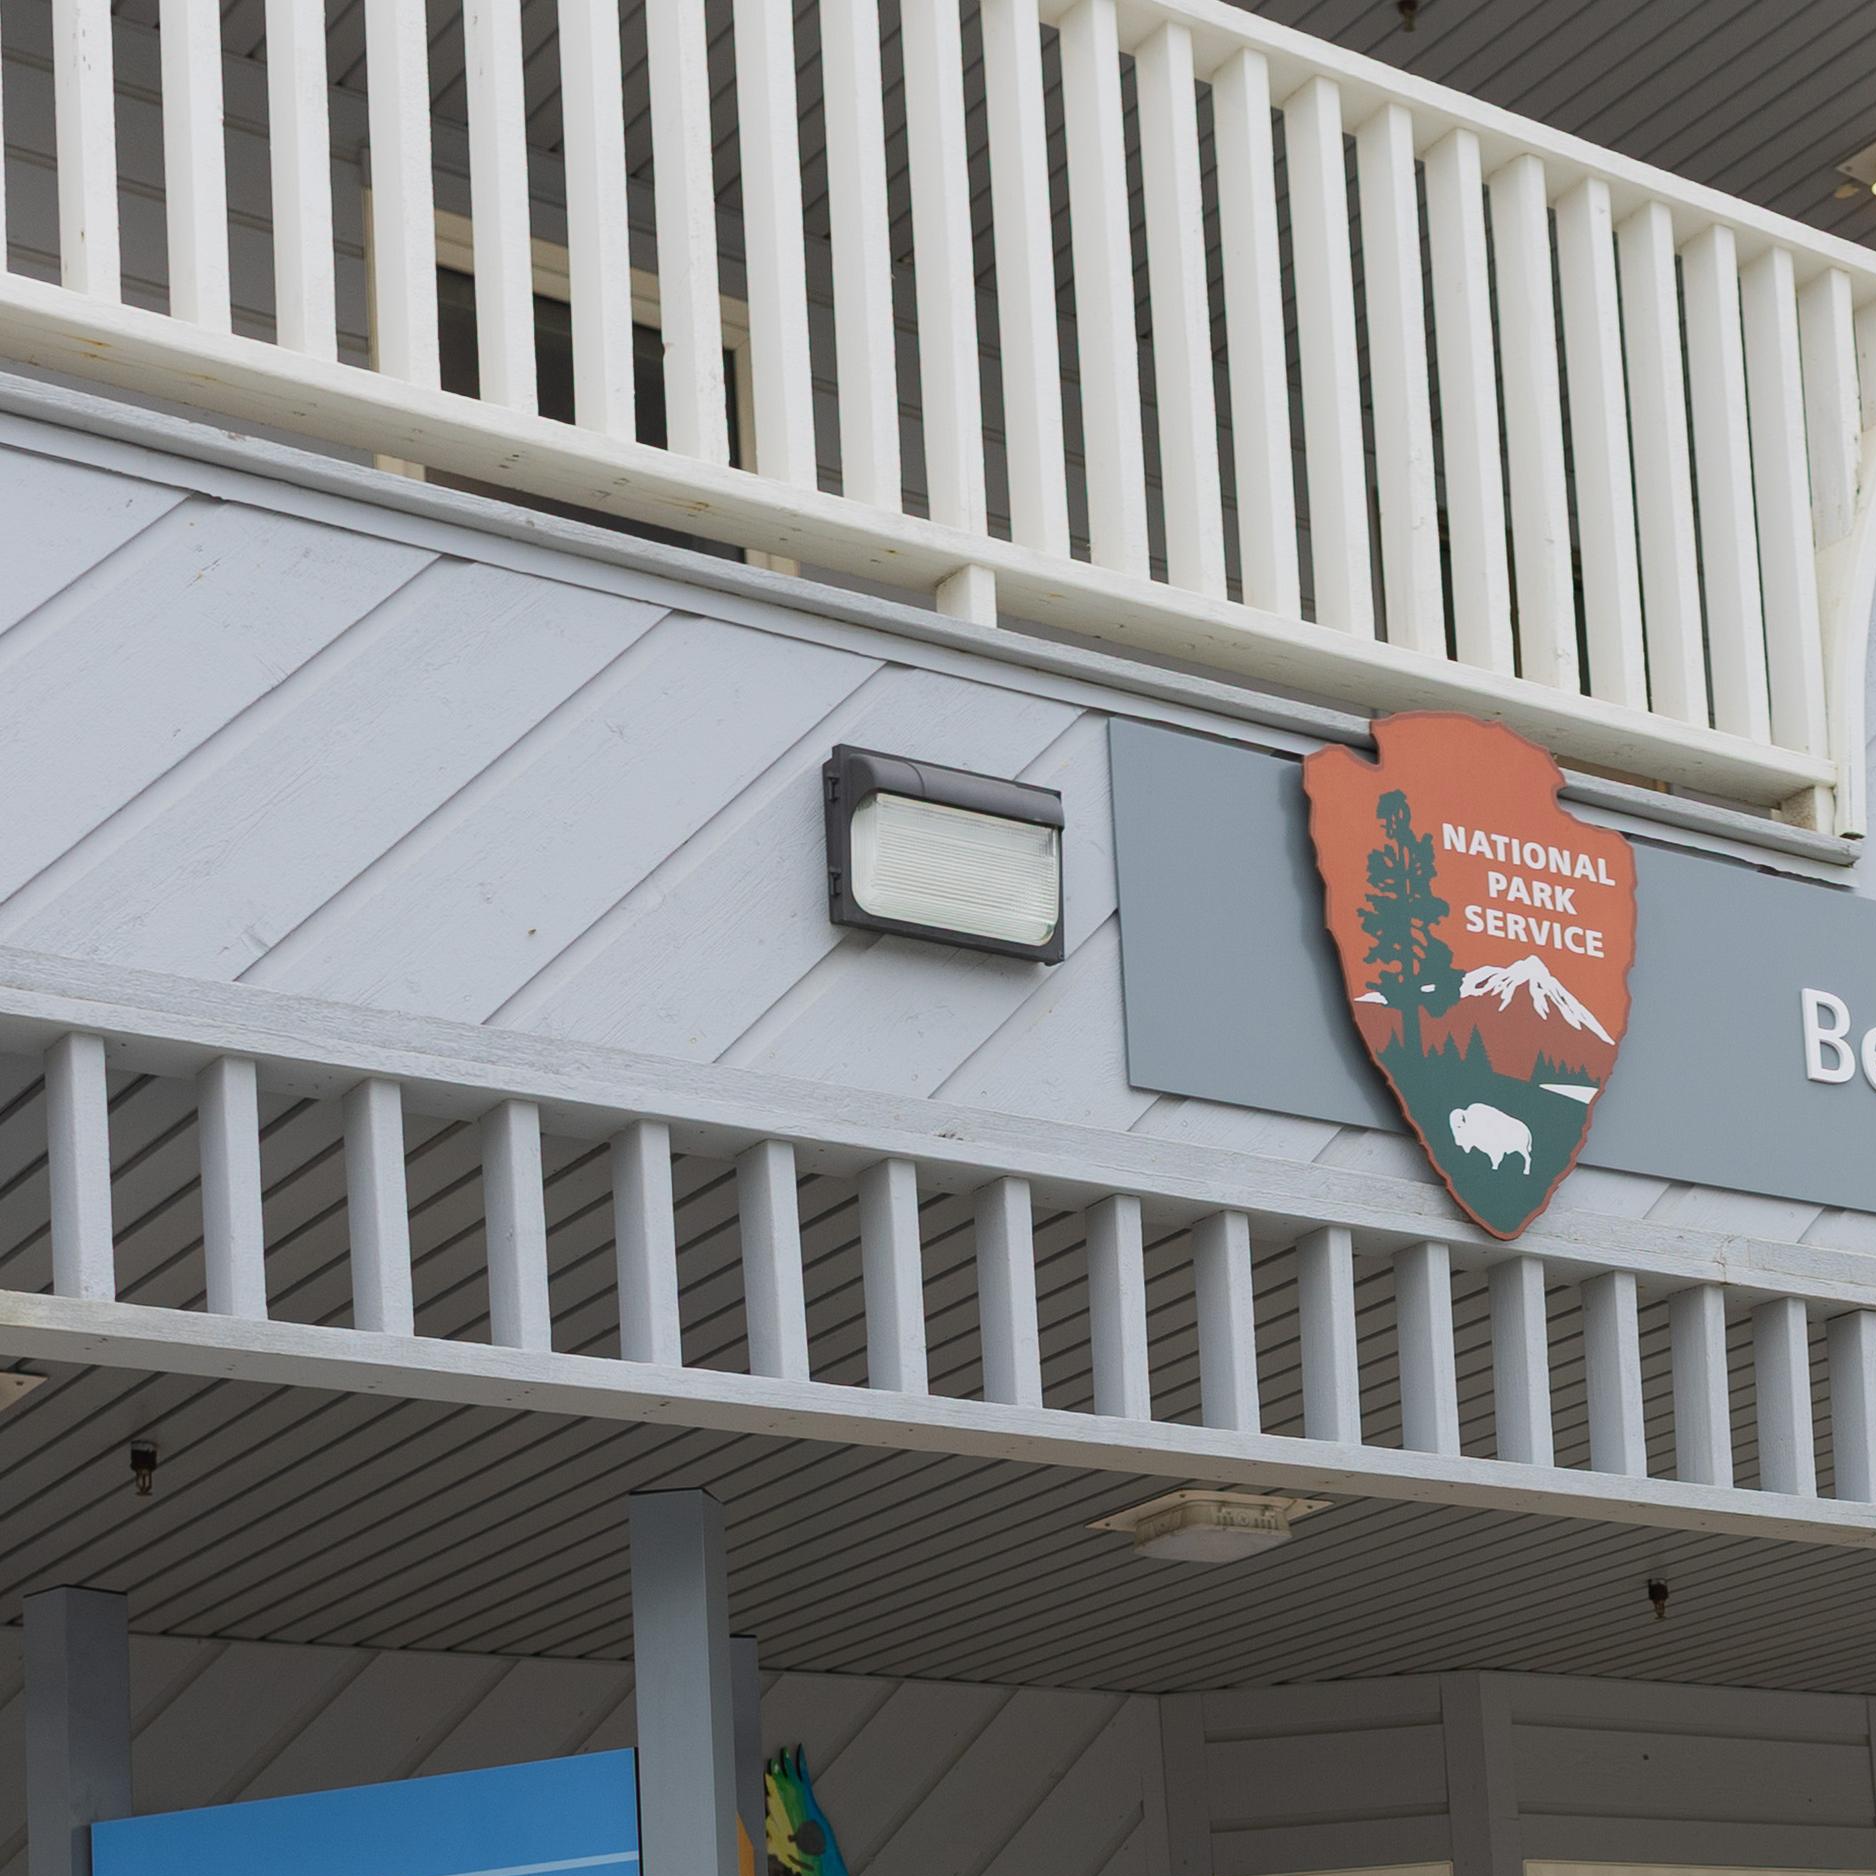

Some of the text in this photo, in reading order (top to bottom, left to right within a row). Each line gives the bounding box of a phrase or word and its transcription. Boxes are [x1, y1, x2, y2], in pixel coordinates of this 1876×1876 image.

[1442, 822, 1616, 887] NATIONAL
[1487, 871, 1578, 915] PARK
[1464, 904, 1605, 958] SERVICE
